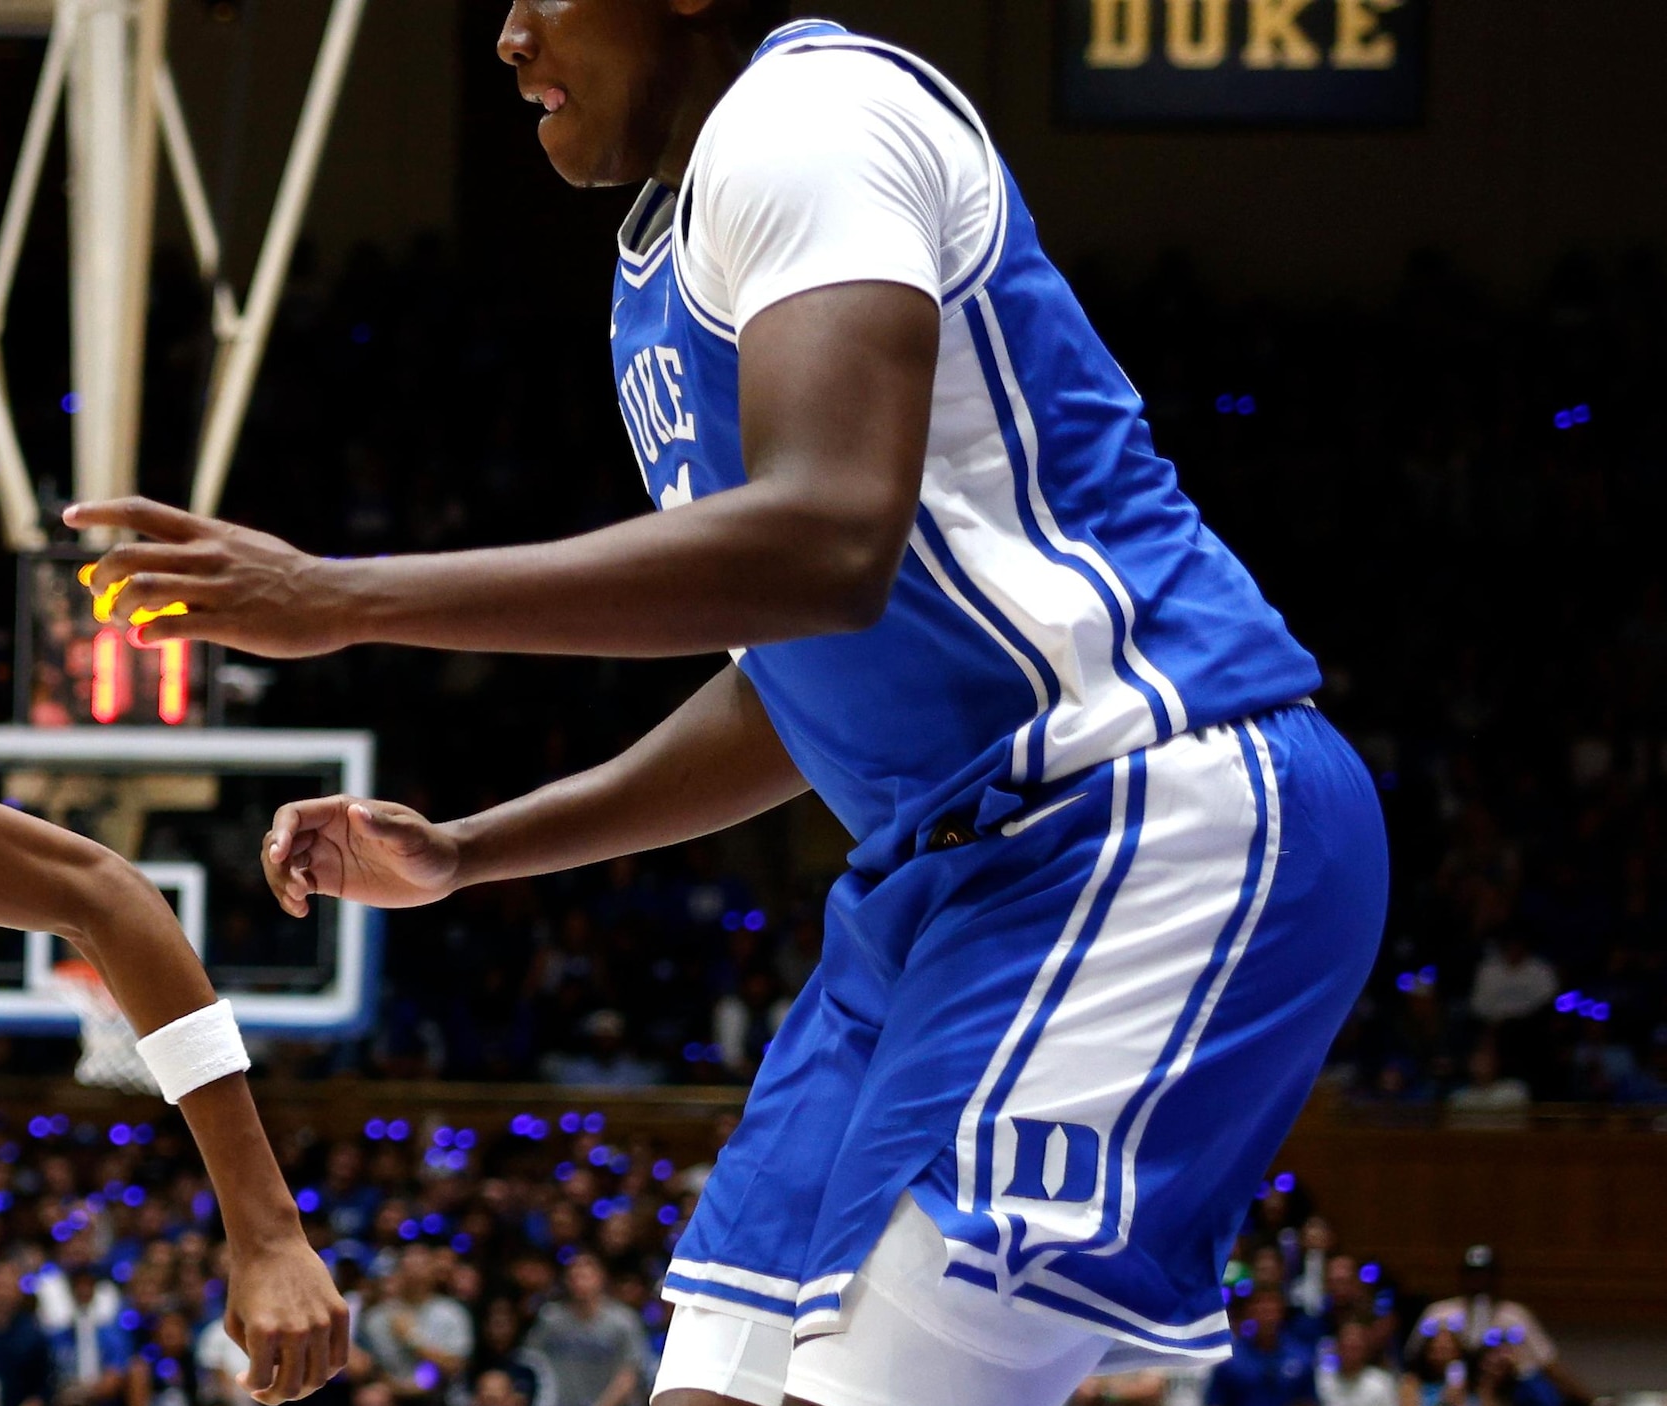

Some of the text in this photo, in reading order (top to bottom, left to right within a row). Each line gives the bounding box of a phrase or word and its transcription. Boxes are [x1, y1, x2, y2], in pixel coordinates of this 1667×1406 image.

[1083, 0, 1399, 70] DUKE
[618, 345, 696, 480] UKE
[1001, 1116, 1100, 1203] D
